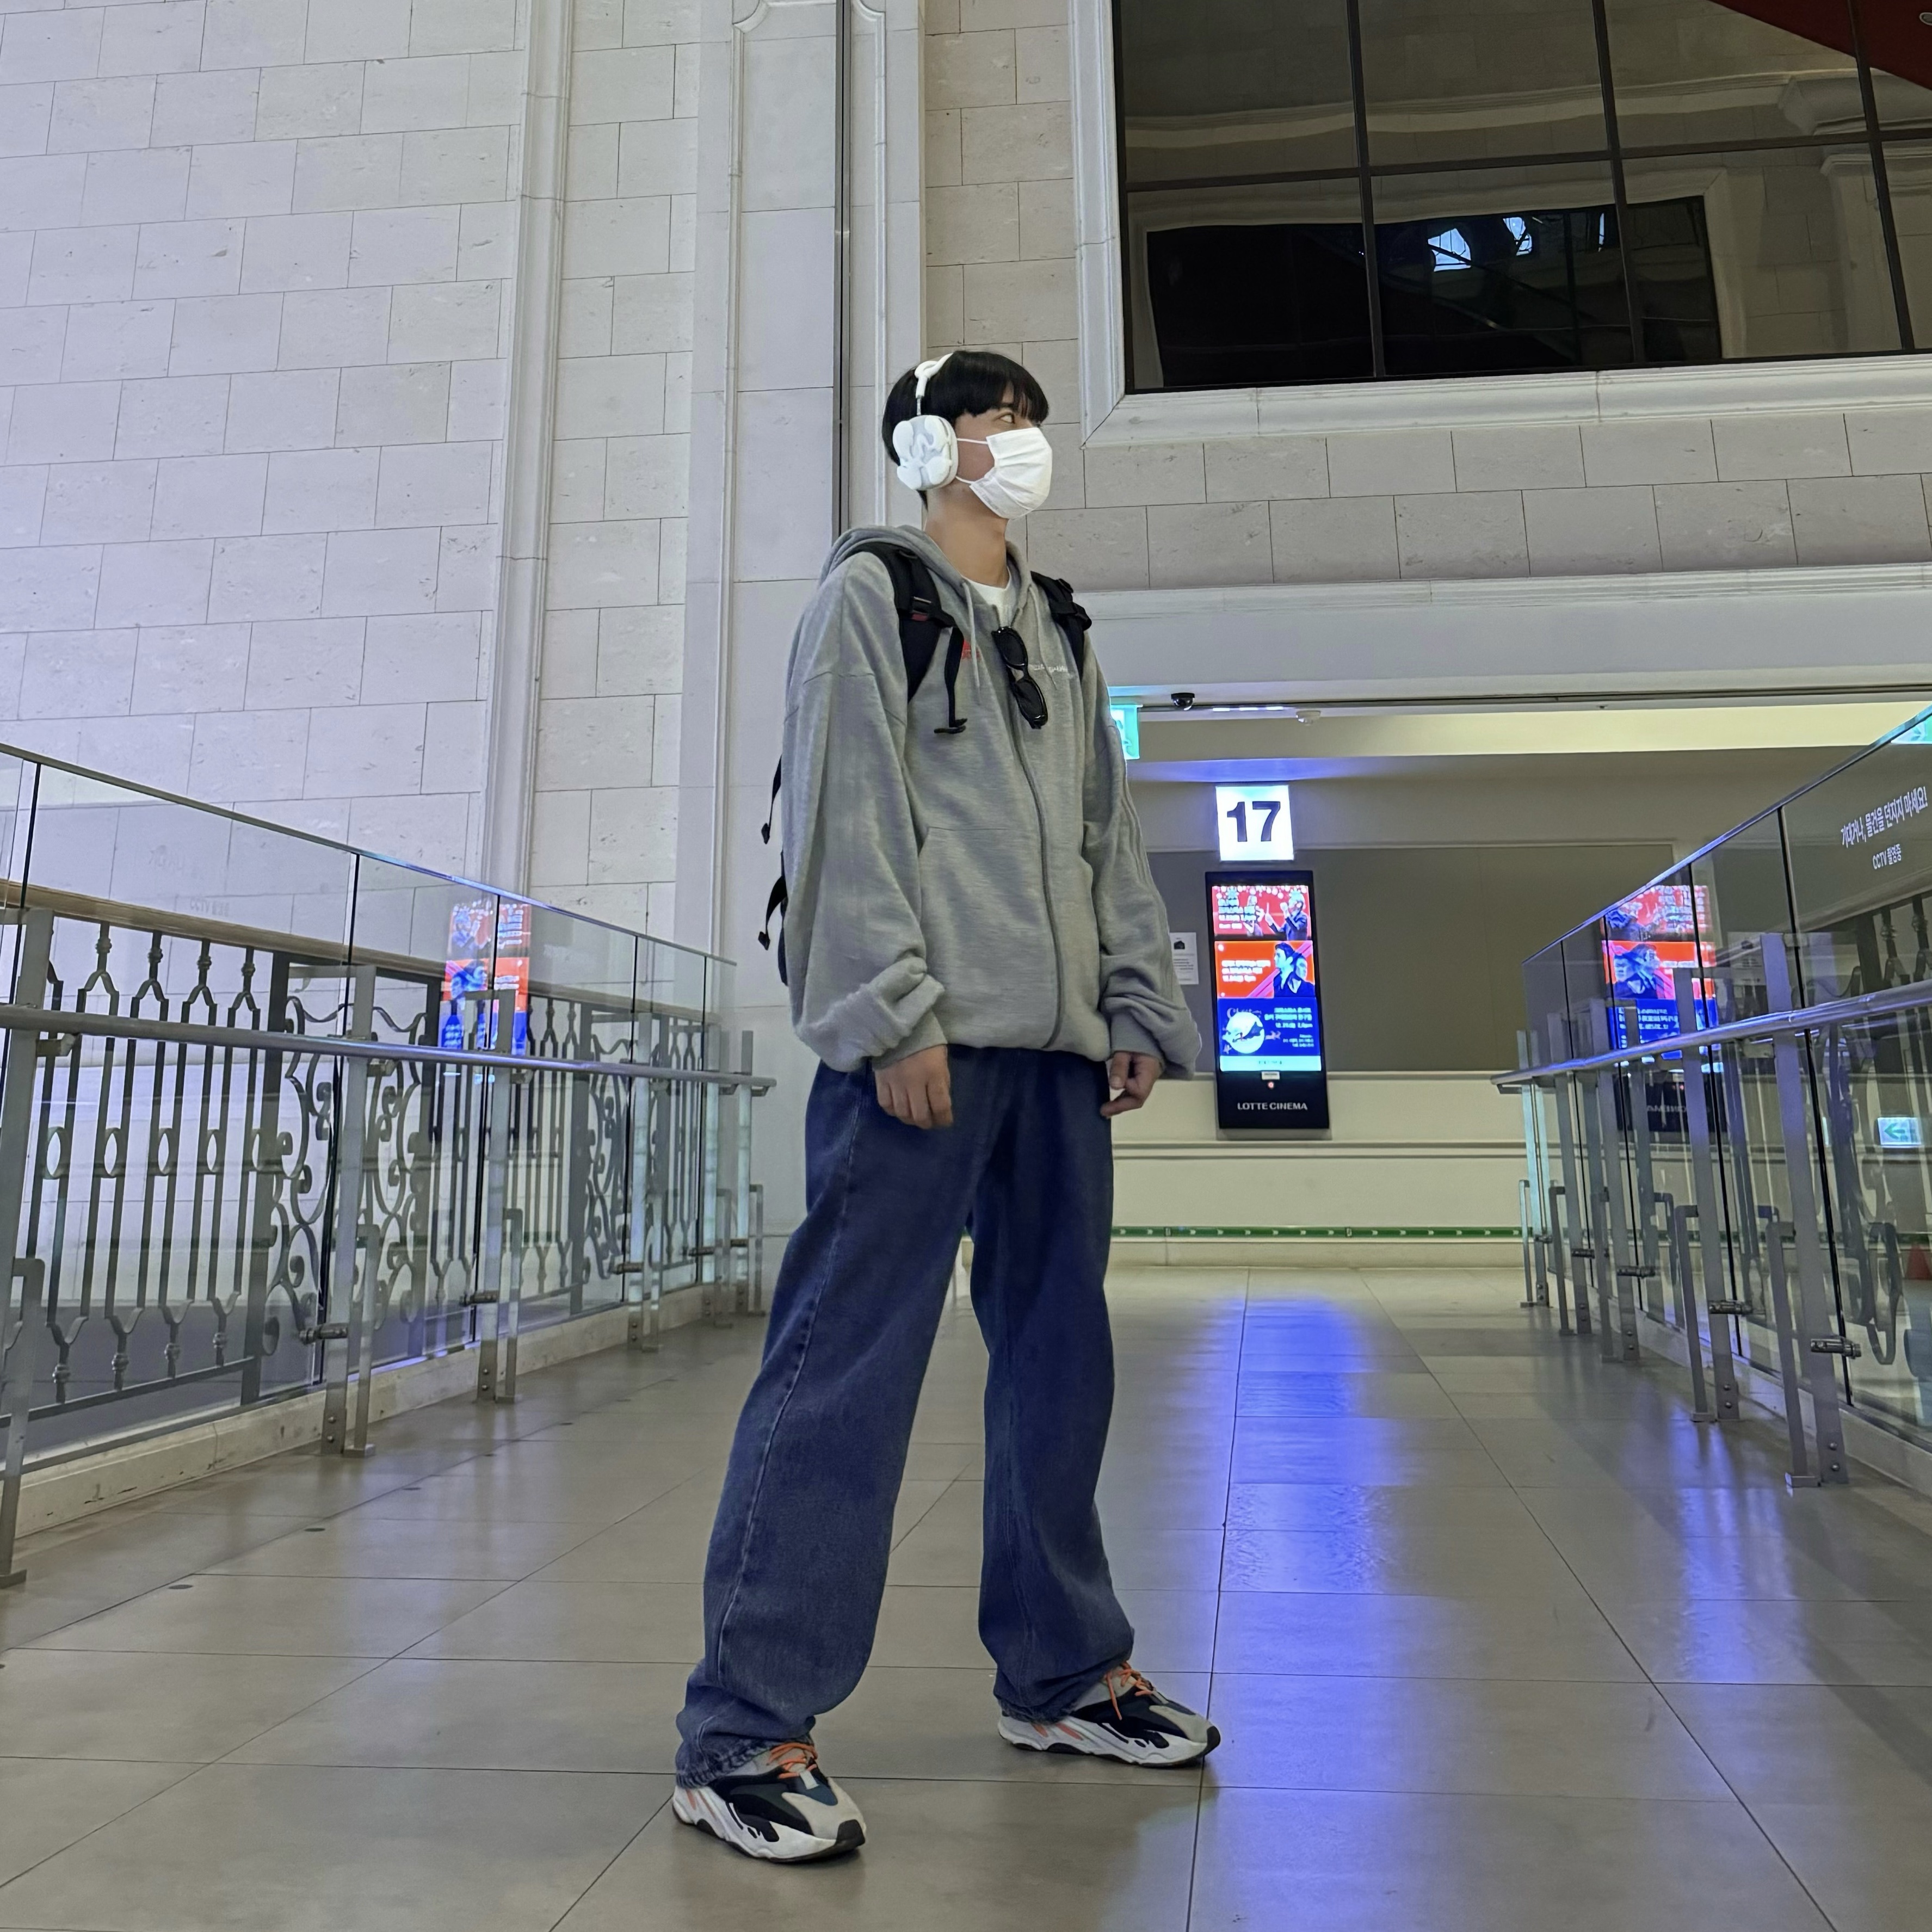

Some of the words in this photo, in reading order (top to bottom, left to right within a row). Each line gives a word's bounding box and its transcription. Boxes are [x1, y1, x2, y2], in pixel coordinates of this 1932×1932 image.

[1227, 801, 1281, 842] 17
[1841, 817, 1866, 848] 기대거나,
[1866, 807, 1885, 838] 물건을
[1884, 796, 1905, 828] 던지지
[1904, 786, 1928, 817] 마세요!
[1873, 850, 1887, 869] CCTV
[1887, 844, 1902, 865] 촬영중
[1237, 1102, 1268, 1110] LOTTE
[1269, 1102, 1308, 1110] CINEMA
